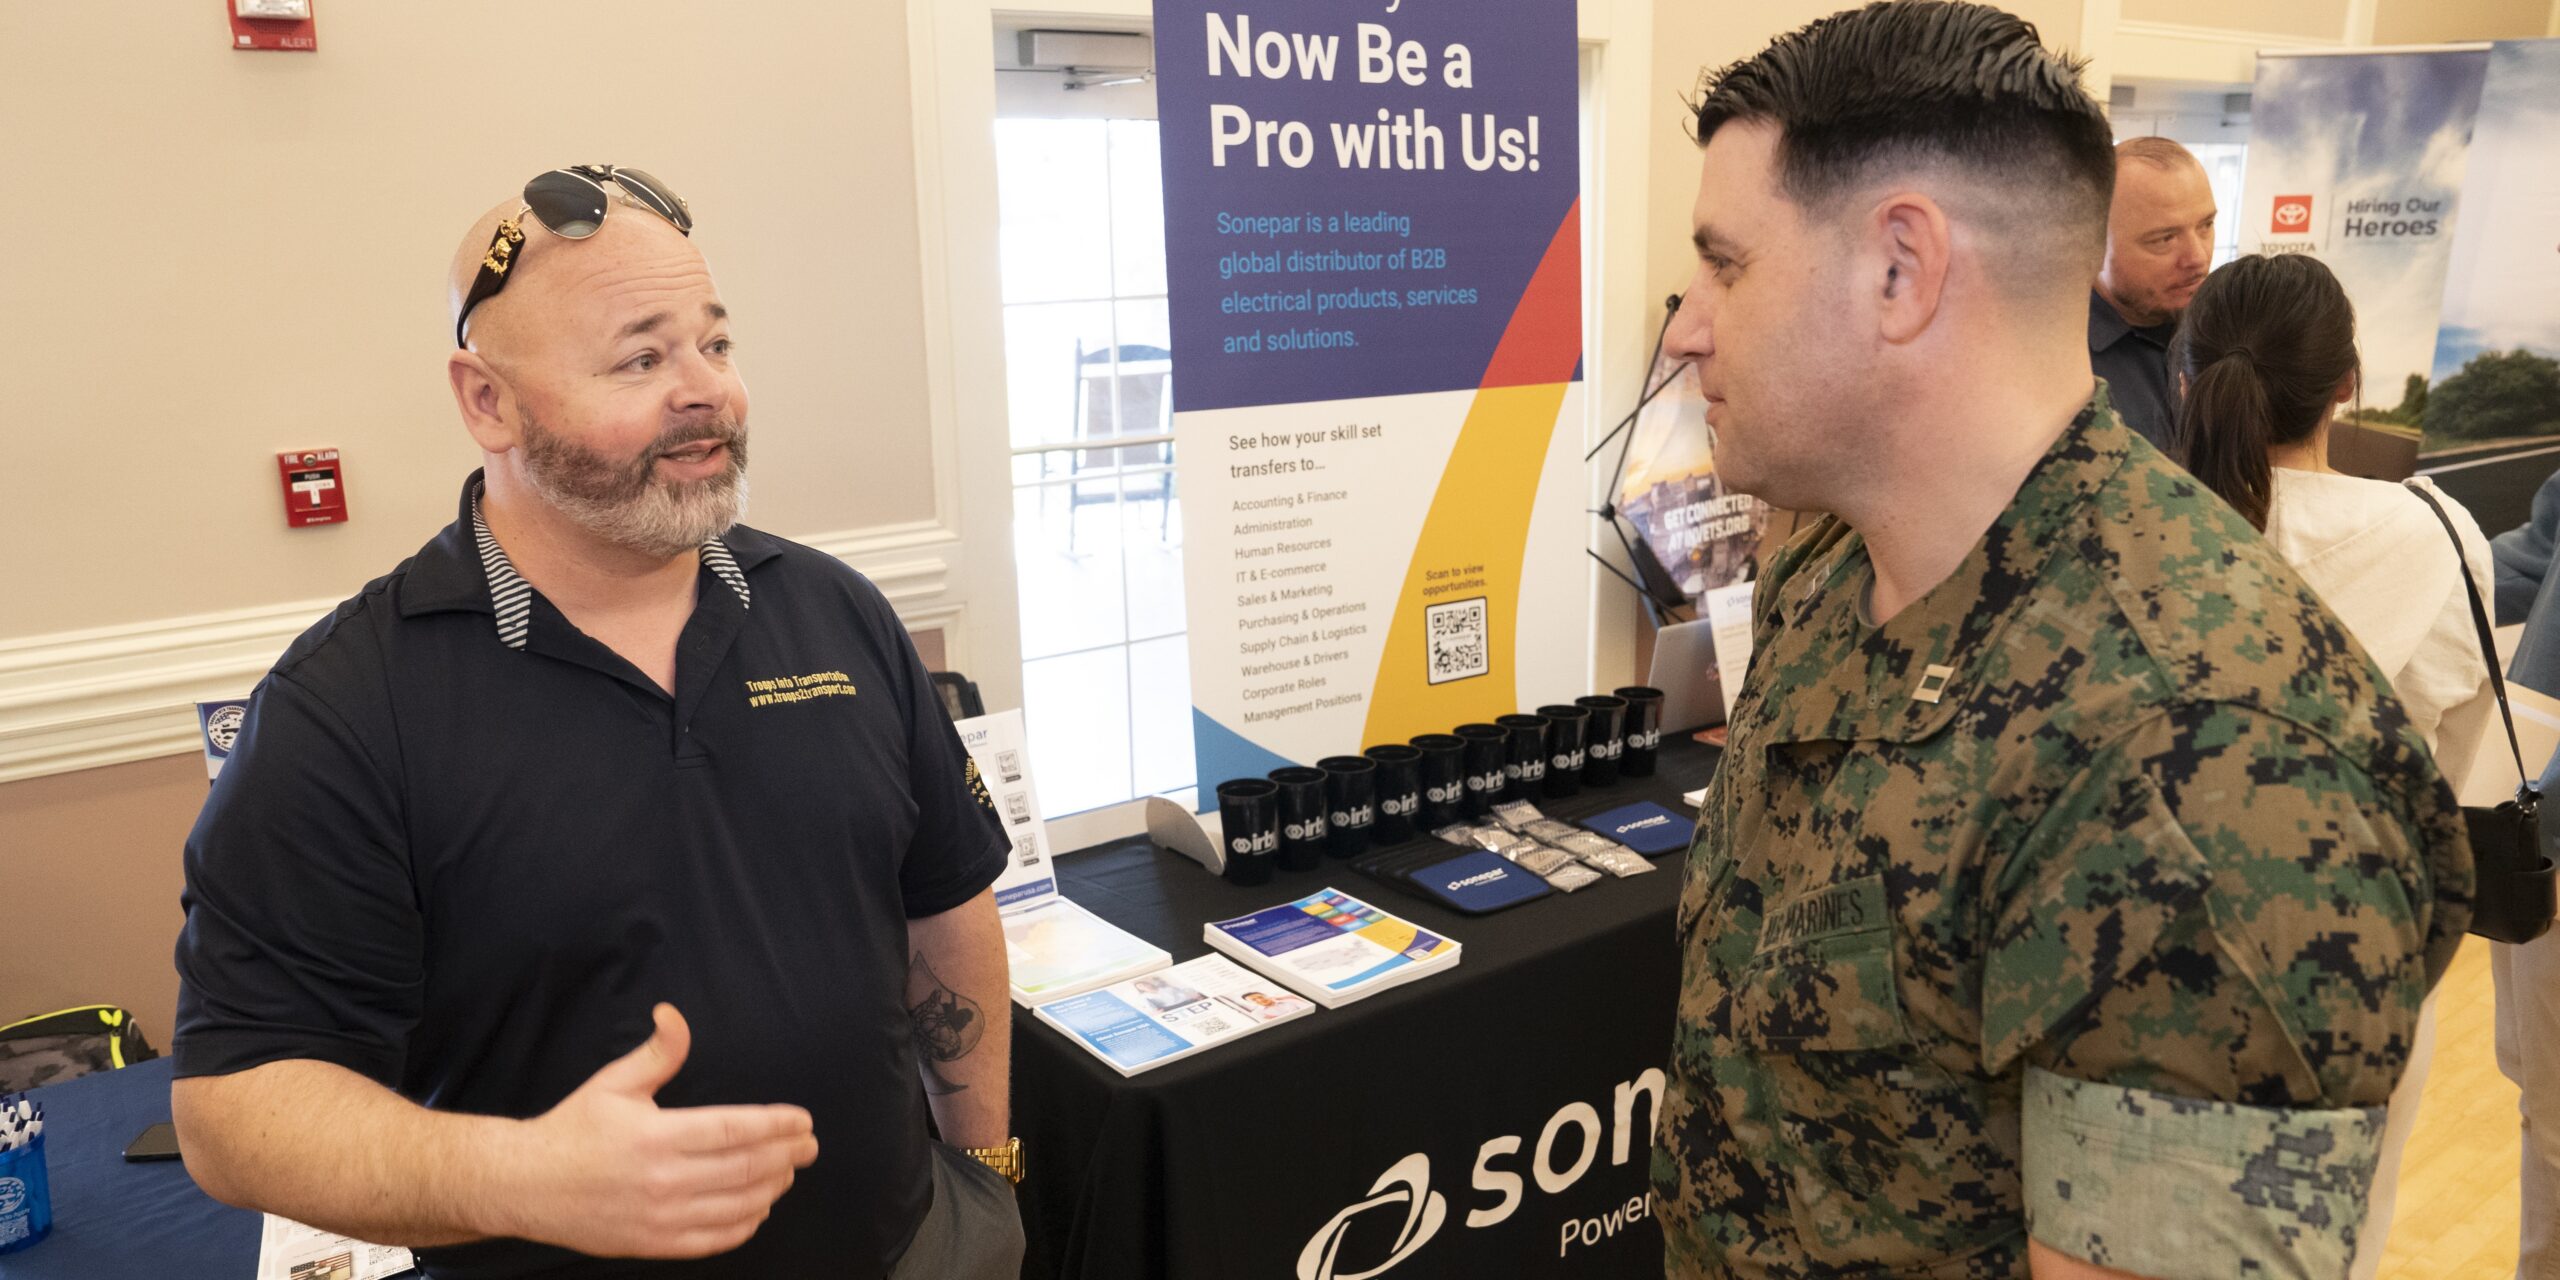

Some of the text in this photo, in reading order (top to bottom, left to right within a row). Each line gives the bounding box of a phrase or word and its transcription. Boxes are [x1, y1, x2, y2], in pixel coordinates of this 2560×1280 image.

[1206, 13, 1473, 88] Now Be a
[1211, 104, 1540, 172] Pro with Us!
[2347, 197, 2441, 216] Hiring Our
[1217, 211, 1410, 238] Sonepar is a leading
[2345, 217, 2438, 237] Heroes
[1219, 248, 1446, 279] global distributor of B2B
[1221, 285, 1477, 314] electrical products, services
[1223, 328, 1359, 353] and solutions.
[1229, 424, 1382, 451] See how your skill set
[1230, 459, 1297, 478] transfers
[1232, 489, 1348, 512] Accounting & Finance
[1664, 493, 1753, 531] GET CONNECTED
[1233, 517, 1313, 536] Administration
[1235, 538, 1332, 560] Human Resources
[1236, 562, 1327, 583] IT & E-commerce
[1426, 565, 1484, 581] Scan to view
[1237, 584, 1333, 607] Sales & Marketing
[1423, 579, 1487, 596] opportunities.
[1238, 601, 1367, 630] Purchasing & Operations
[1240, 624, 1367, 654] Supply Chain & Logistics
[1241, 650, 1349, 677] Warehouse & Drivers
[745, 670, 850, 692] Troops Into Transportation
[1242, 676, 1327, 701] Corporate Roles
[1244, 692, 1363, 724] Management Positions
[1783, 888, 1865, 939] MARINES
